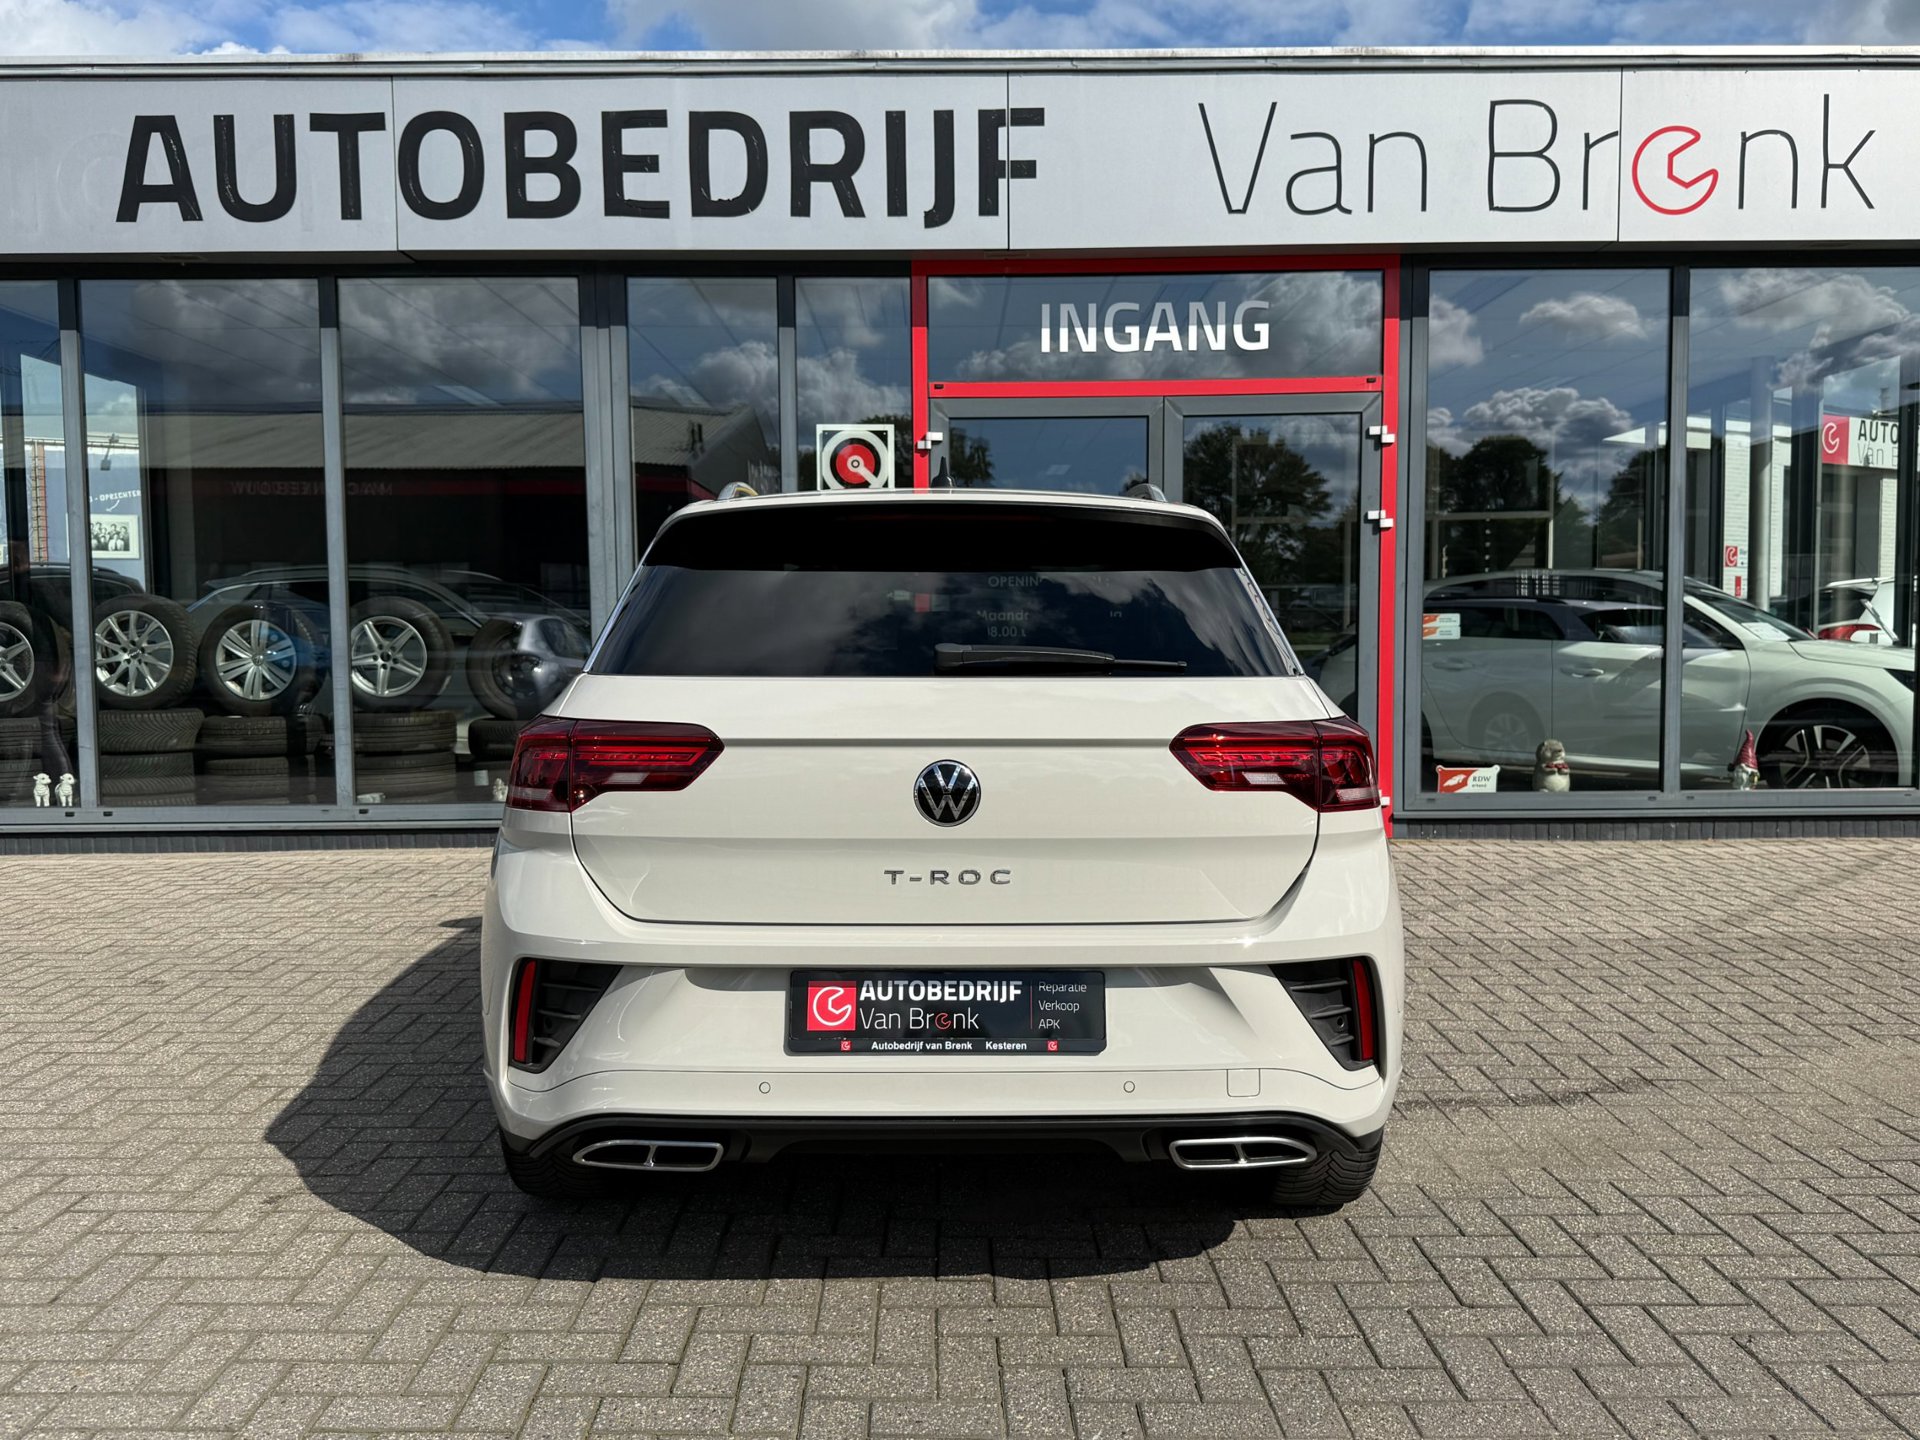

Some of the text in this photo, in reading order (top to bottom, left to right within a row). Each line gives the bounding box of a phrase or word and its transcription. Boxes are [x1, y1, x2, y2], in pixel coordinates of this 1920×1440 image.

[116, 106, 1045, 229] AUTOBEDRIJF
[1199, 101, 1428, 215] Van
[1041, 301, 1270, 352] INGANG
[884, 869, 1011, 886] T-ROC
[859, 980, 1023, 1003] AUTOBEDRIJF
[1038, 981, 1087, 995] Reparatie
[1038, 1000, 1080, 1013] Verkoop
[859, 1007, 901, 1030] Van
[1038, 1018, 1061, 1030] APK
[871, 1041, 1027, 1052] Autobedrijf van Brenk Kesteren
